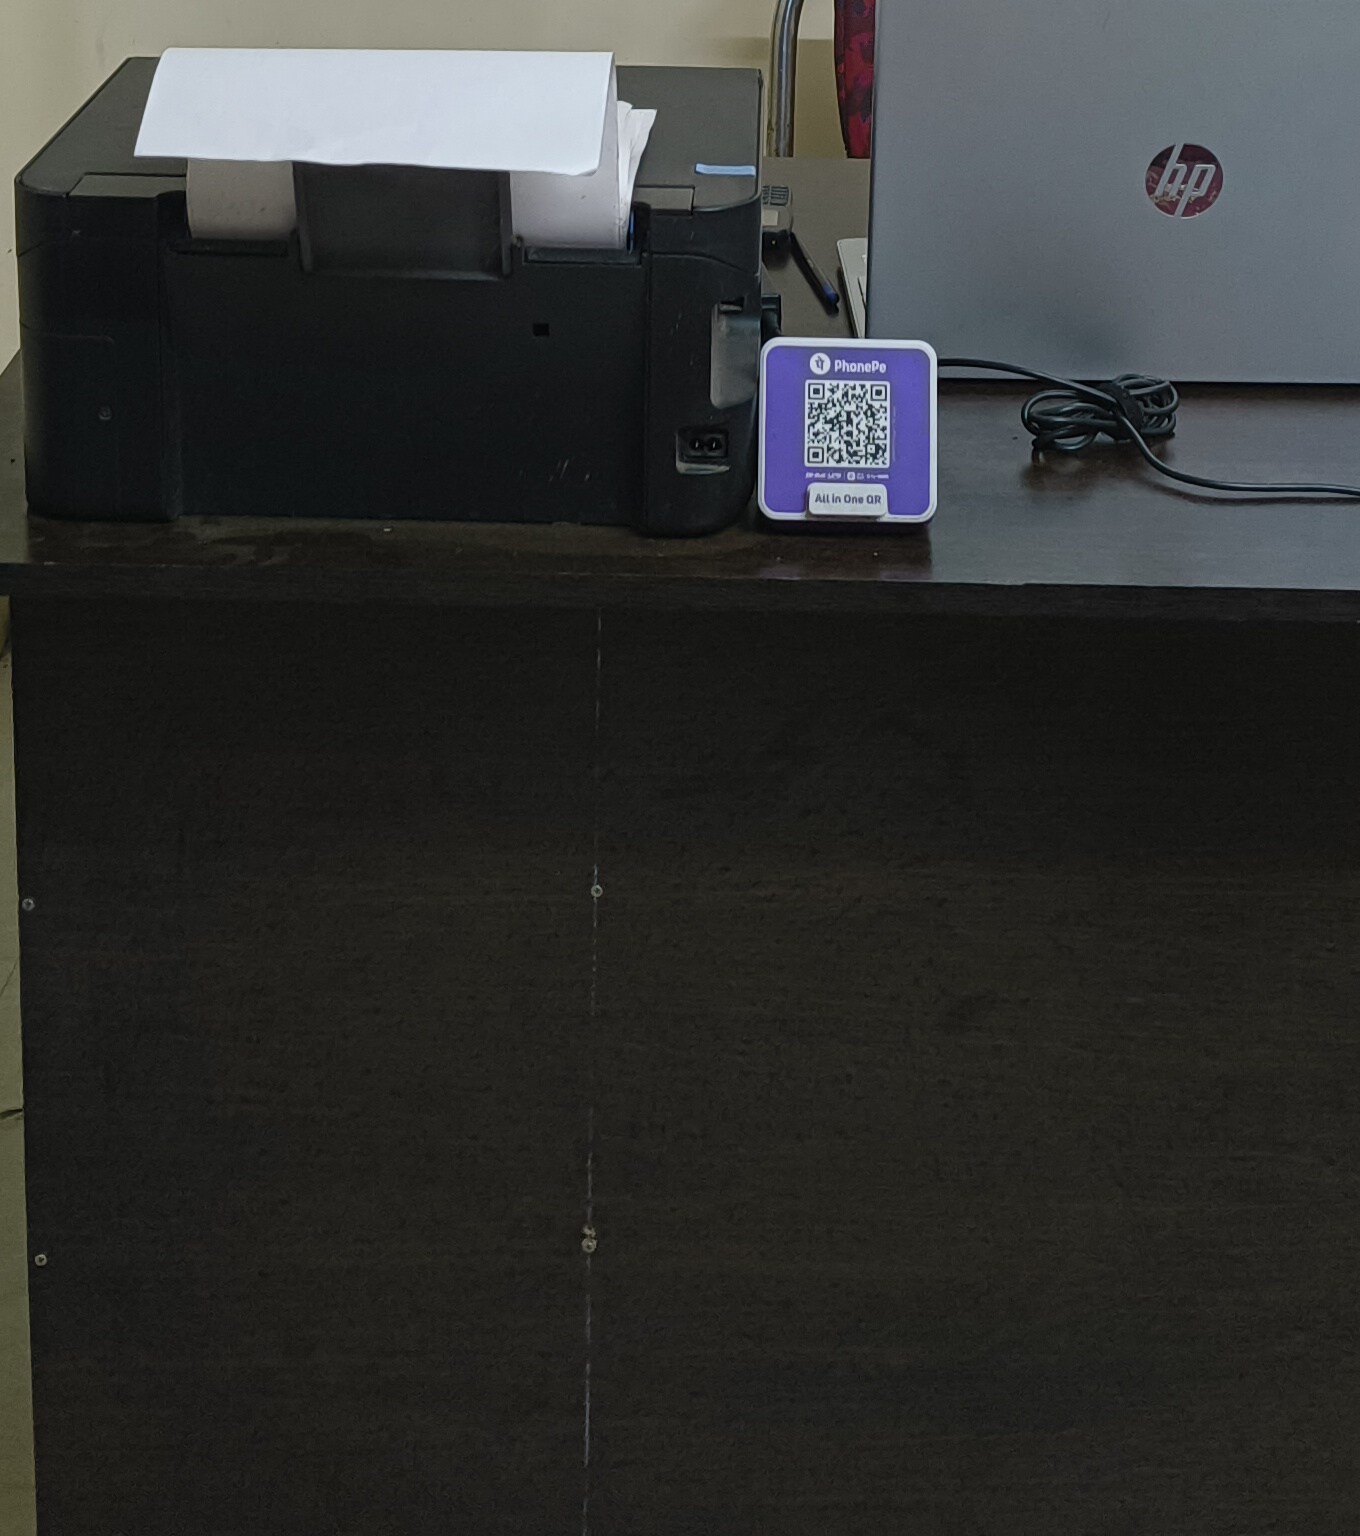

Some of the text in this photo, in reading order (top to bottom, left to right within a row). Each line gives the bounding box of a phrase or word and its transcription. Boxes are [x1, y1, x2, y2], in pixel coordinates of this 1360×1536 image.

[1156, 143, 1217, 217] hp
[834, 359, 887, 374] PhonePe
[815, 493, 882, 505] All in One QR
